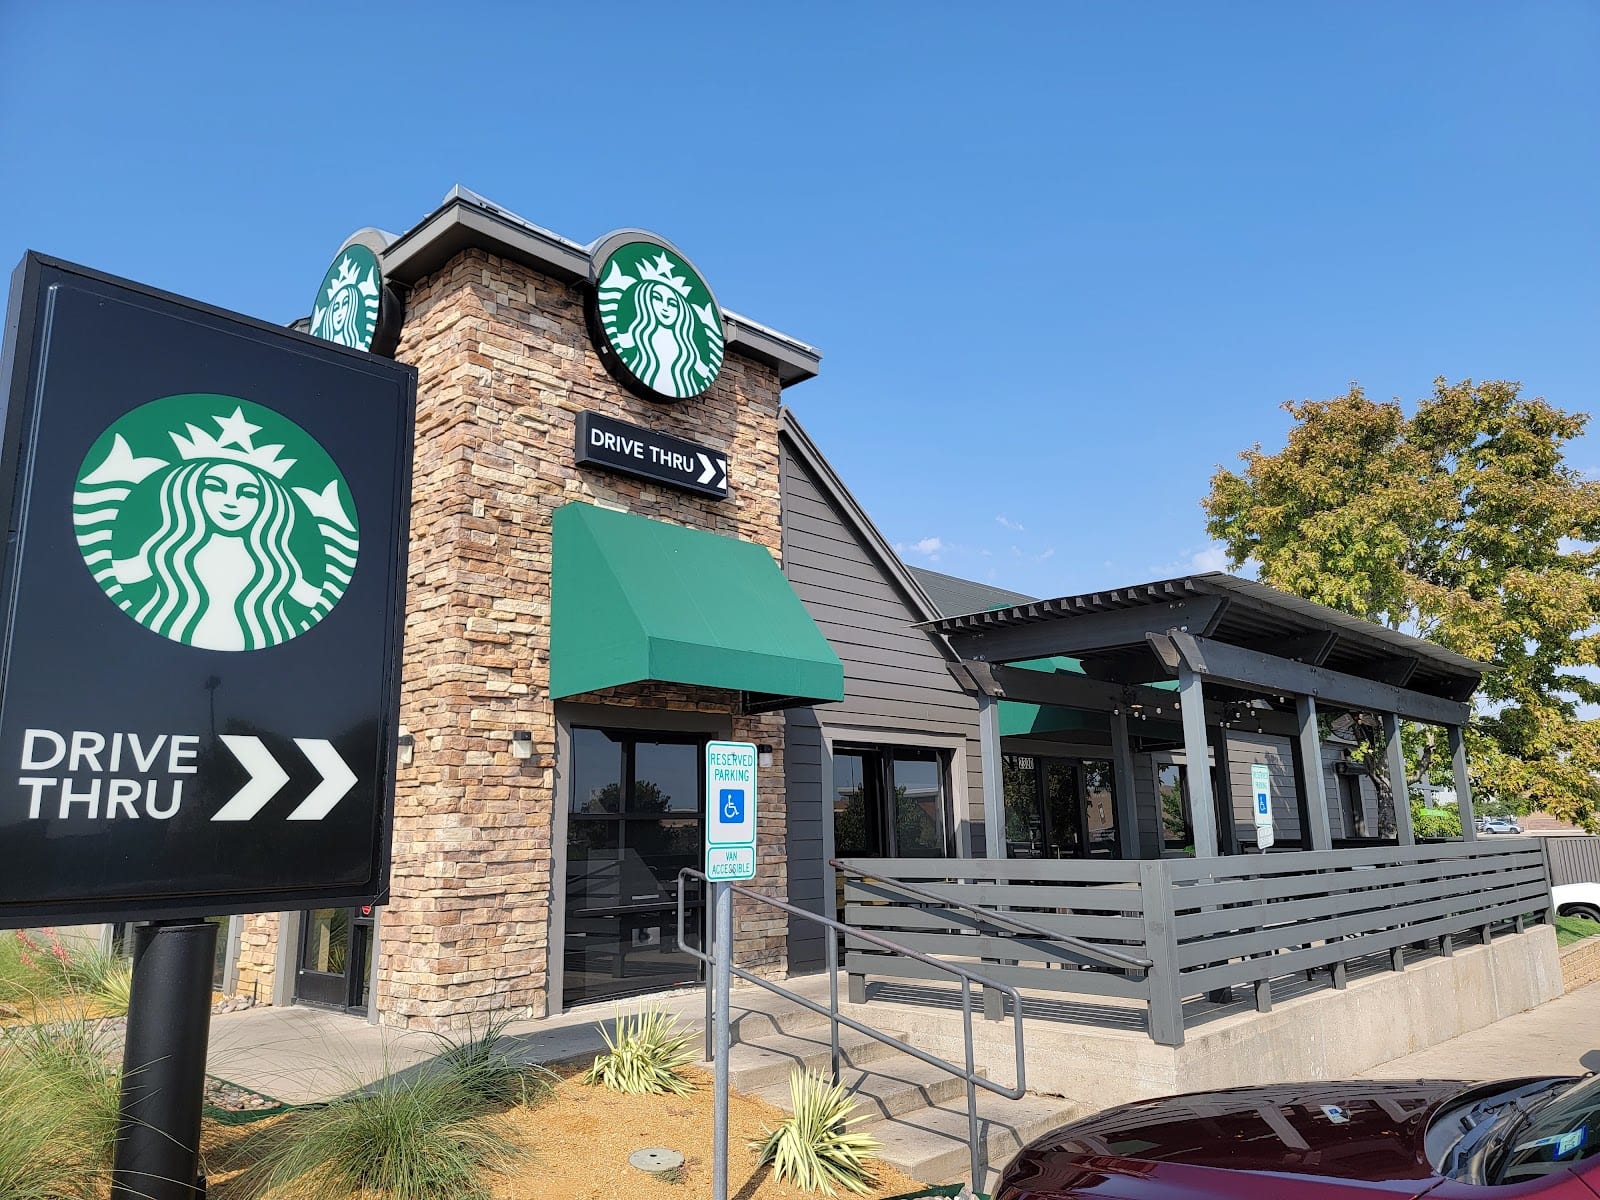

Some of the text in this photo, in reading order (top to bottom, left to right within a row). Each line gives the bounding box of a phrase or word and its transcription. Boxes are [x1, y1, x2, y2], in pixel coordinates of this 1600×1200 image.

[591, 428, 694, 473] DRIVE THRU
[21, 728, 200, 774] DRIVE
[710, 753, 753, 767] RESERVED
[714, 768, 750, 782] PARKING
[18, 776, 183, 820] THRU
[726, 851, 738, 861] VAN
[712, 863, 751, 875] ACCESSIBLE
